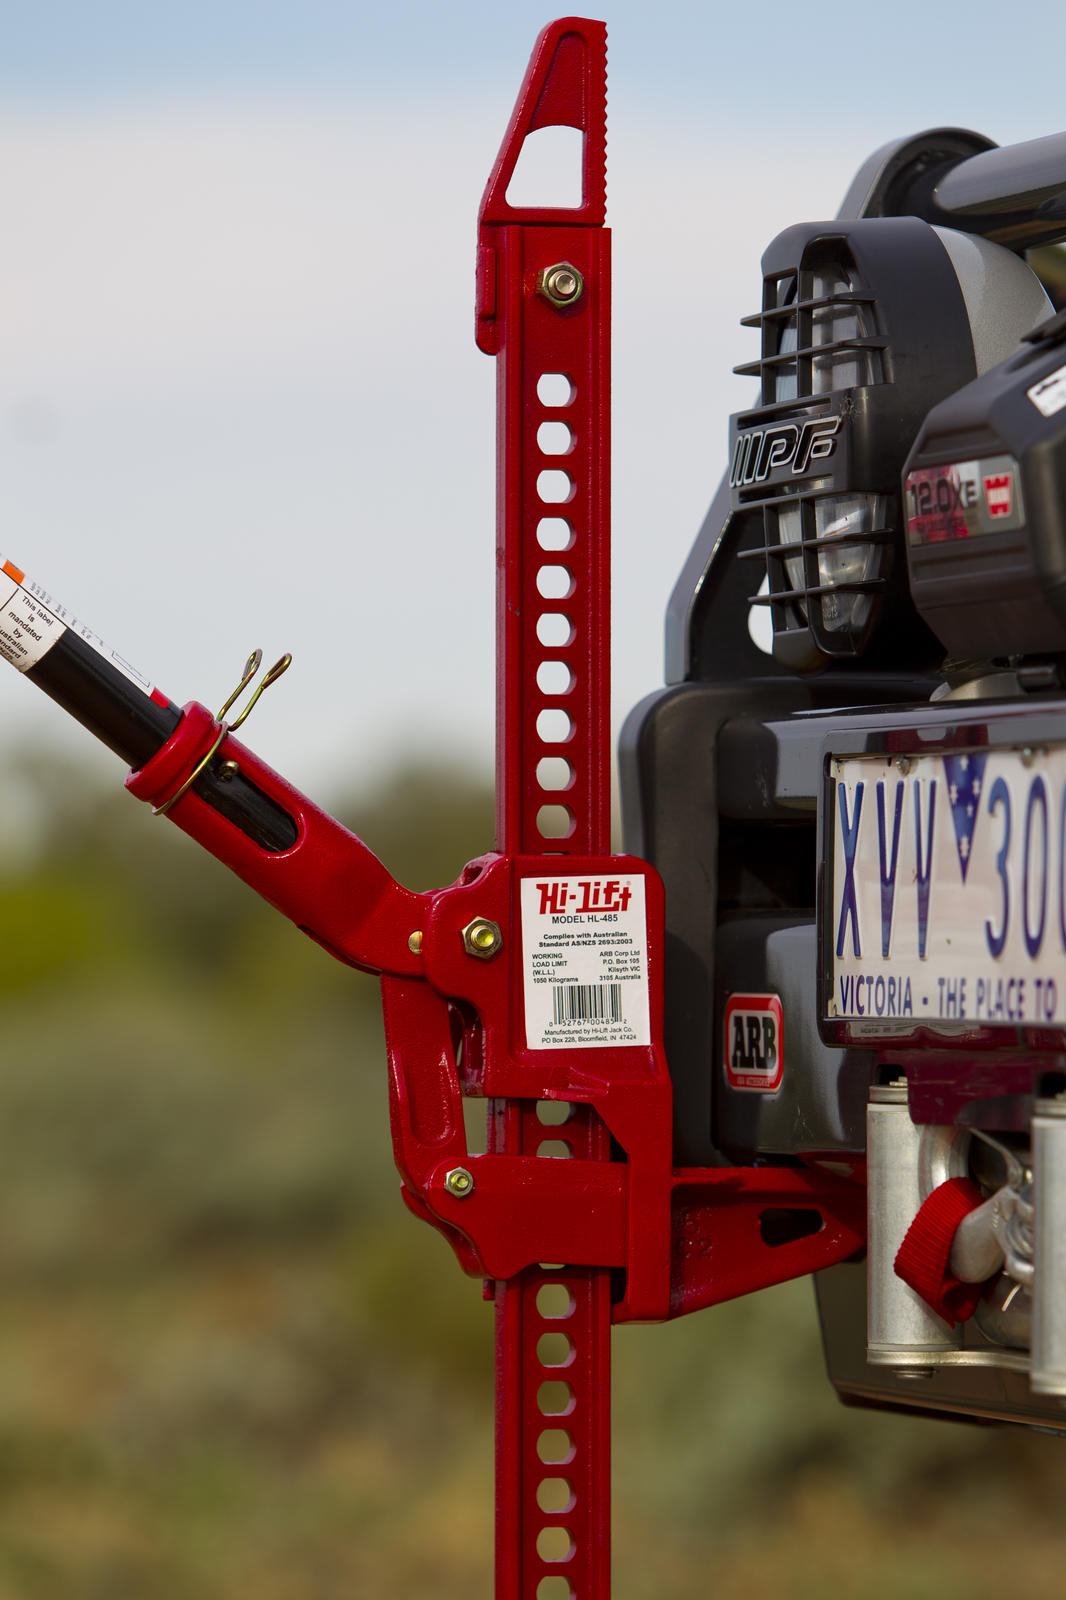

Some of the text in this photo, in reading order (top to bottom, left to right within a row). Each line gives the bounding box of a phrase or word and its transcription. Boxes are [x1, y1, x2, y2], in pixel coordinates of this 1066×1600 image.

[22, 595, 37, 612] This
[36, 608, 54, 628] label
[27, 613, 35, 623] is
[8, 611, 43, 642] mandated
[13, 627, 23, 639] by
[0, 625, 28, 656] ustralian
[536, 881, 632, 914] Hi-Lift
[551, 913, 619, 924] MODEL HL-485
[543, 933, 575, 941] Complies
[571, 939, 597, 947] AS/NZS
[531, 952, 563, 960] WORKING
[614, 950, 629, 958] Corp
[608, 966, 629, 974] Kilsyth
[548, 976, 579, 984] Kilograms
[840, 975, 913, 1017] VICTORIA
[938, 977, 967, 1018] THE
[976, 977, 1024, 1020] PLACE
[1034, 978, 1058, 1021] TO
[562, 1019, 586, 1027] 52767
[544, 1028, 582, 1036] Manufactured
[591, 1026, 608, 1034] Hi-Lift
[577, 1034, 608, 1043] Bloomfield,
[731, 1015, 777, 1069] ARB
